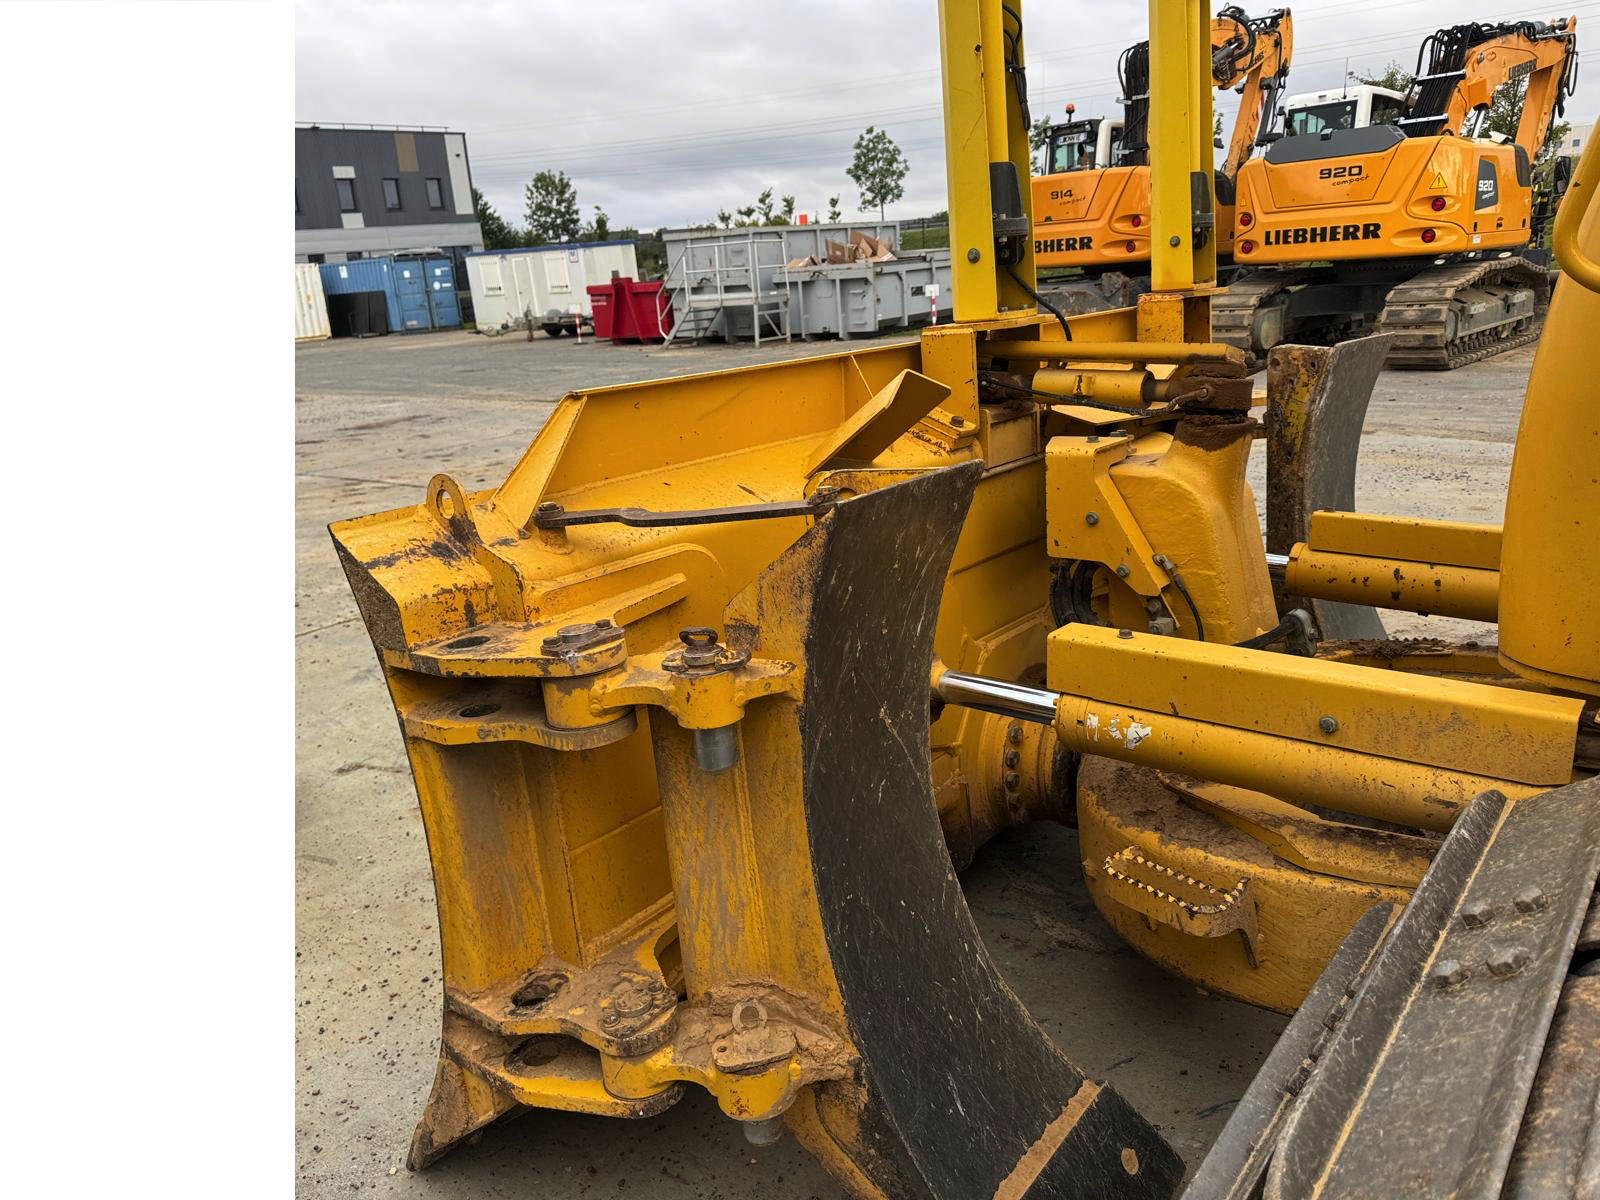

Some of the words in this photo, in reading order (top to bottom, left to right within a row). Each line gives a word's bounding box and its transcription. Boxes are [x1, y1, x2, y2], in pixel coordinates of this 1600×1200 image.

[1319, 165, 1362, 179] 920
[1331, 173, 1370, 187] compact
[1477, 180, 1494, 192] 920
[1050, 189, 1073, 200] 914
[1264, 222, 1382, 246] LIEBHERR
